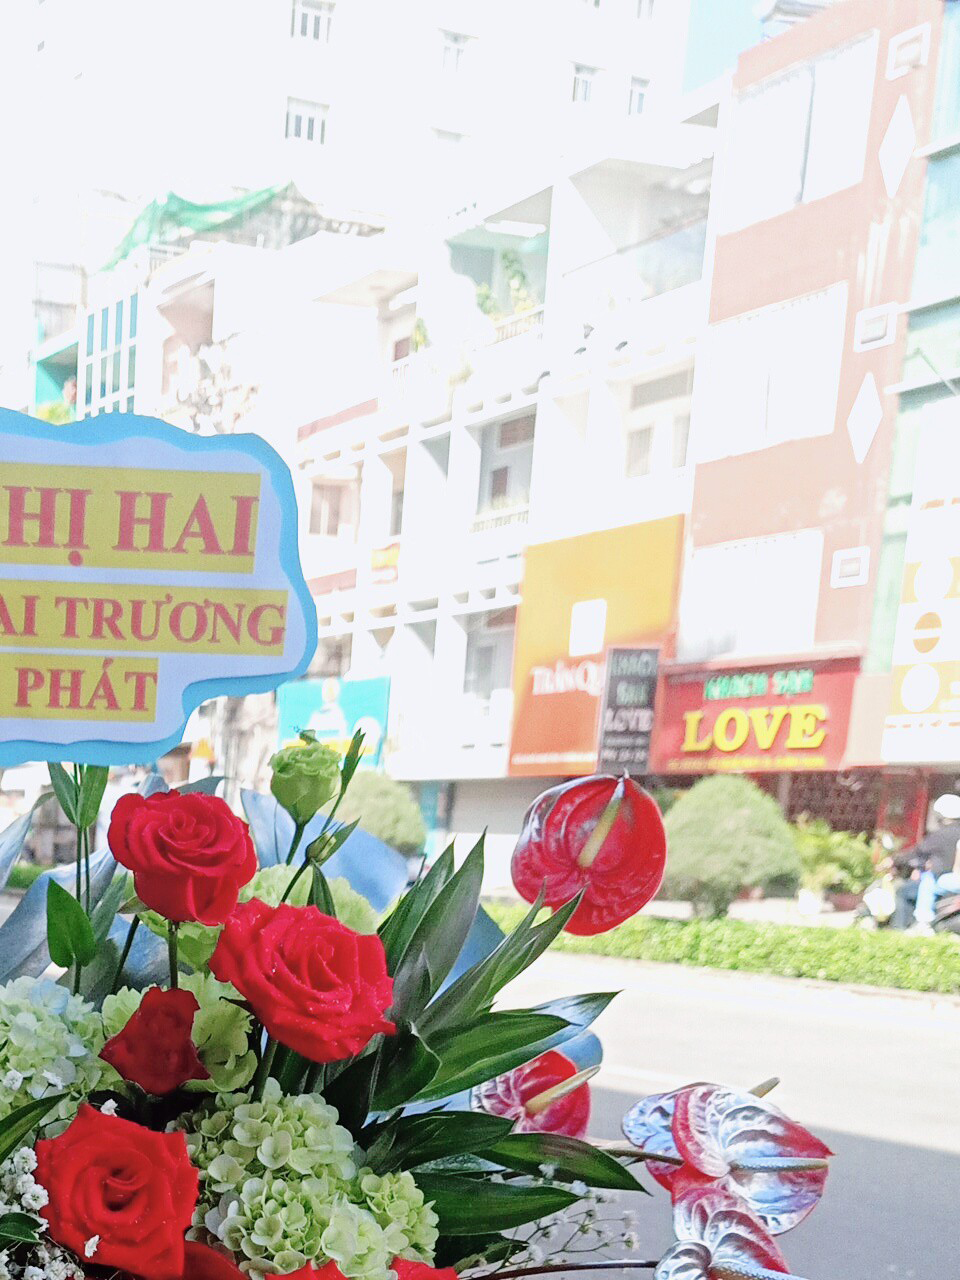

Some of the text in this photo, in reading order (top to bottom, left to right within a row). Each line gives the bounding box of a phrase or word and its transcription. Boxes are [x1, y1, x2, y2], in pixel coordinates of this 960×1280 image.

[112, 490, 260, 557] HAI
[54, 592, 287, 647] TRƯƠNG
[15, 656, 158, 712] PHÁT
[681, 704, 828, 753] LOVE
